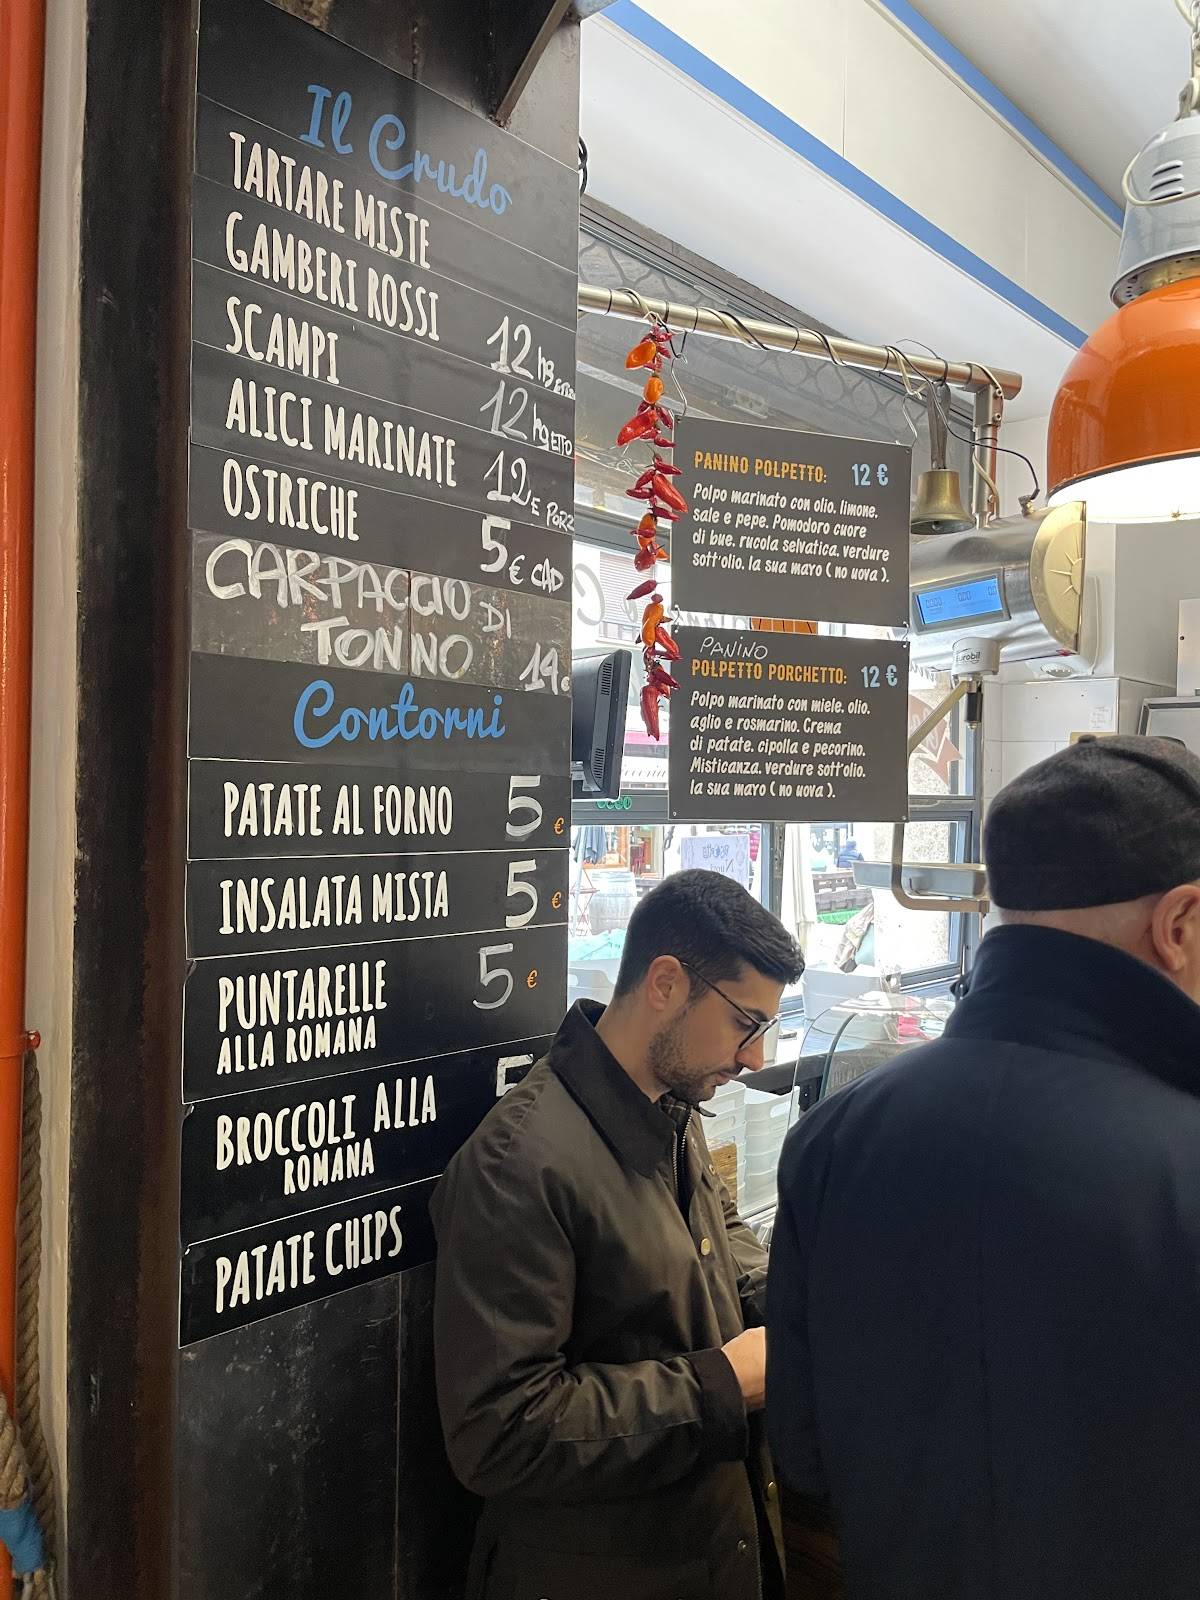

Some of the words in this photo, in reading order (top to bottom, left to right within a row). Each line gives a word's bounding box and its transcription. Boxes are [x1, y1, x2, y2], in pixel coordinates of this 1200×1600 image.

[300, 85, 353, 154] Il
[369, 114, 512, 214] Crudo
[229, 132, 345, 233] TARTARE
[355, 189, 431, 269] MISTE
[226, 212, 358, 312] GAMBERI
[368, 267, 440, 341] ROSSI
[226, 297, 339, 384] SCAMPI
[486, 315, 534, 380] 12
[226, 378, 313, 450] ALICI
[324, 404, 457, 488] MARINATE
[480, 380, 528, 440] 12
[550, 431, 573, 456] ETTO
[223, 458, 360, 541] OSTRICHE
[483, 450, 532, 506] 12
[693, 482, 728, 503] Polpo
[730, 489, 787, 509] marinato
[790, 496, 811, 510] con
[694, 450, 749, 474] PANINO
[755, 458, 827, 484] POLPETTO:
[851, 463, 871, 486] 12
[876, 463, 889, 486] €
[480, 515, 511, 573] 5
[509, 554, 525, 585] €
[692, 529, 706, 545] di
[739, 533, 779, 553] rucola
[843, 544, 891, 563] verdure
[693, 507, 720, 524] sale
[724, 511, 732, 525] e
[772, 513, 831, 536] Pomodoro
[833, 522, 867, 539] cuore
[205, 538, 473, 621] CARPACCIO
[479, 601, 512, 640] DI
[748, 556, 761, 572] la
[764, 558, 787, 574] sua
[834, 565, 848, 579] no
[850, 567, 879, 582] uova
[300, 615, 474, 680] TONNO
[691, 659, 763, 680] POLPETTO
[768, 663, 848, 685] PORCHETTO:
[860, 665, 881, 688] 12
[885, 664, 898, 687] €
[293, 679, 507, 749] Contorni
[690, 690, 725, 710] Polpo
[727, 693, 784, 712] marinato
[787, 697, 808, 712] con
[690, 713, 721, 731] aglio
[724, 717, 733, 730] e
[803, 717, 842, 735] Crema
[690, 735, 703, 752] di
[757, 738, 798, 756] cipolla
[801, 744, 810, 755] e
[764, 758, 814, 777] verdure
[223, 781, 323, 838] PATATE
[332, 785, 364, 836] AL
[373, 784, 454, 837] FORNO
[504, 775, 543, 838] 5
[553, 816, 565, 836] €
[690, 779, 703, 796] la
[706, 781, 730, 796] sua
[778, 784, 793, 797] no
[795, 785, 824, 798] uova
[218, 874, 362, 935] INSALATA
[372, 870, 449, 924] MISTA
[505, 859, 539, 929] 5
[551, 891, 562, 910] €
[218, 959, 388, 1033] PUNTARELLE
[472, 943, 514, 1010] 5
[526, 968, 538, 989] €
[216, 1031, 275, 1076] ALLA
[285, 1015, 377, 1064] ROMANA
[216, 1094, 357, 1171] BROCCOLI
[374, 1075, 437, 1133] ALLA
[284, 1137, 375, 1196] ROMANA
[216, 1230, 316, 1314] PATATE
[325, 1205, 403, 1277] CHIPS
